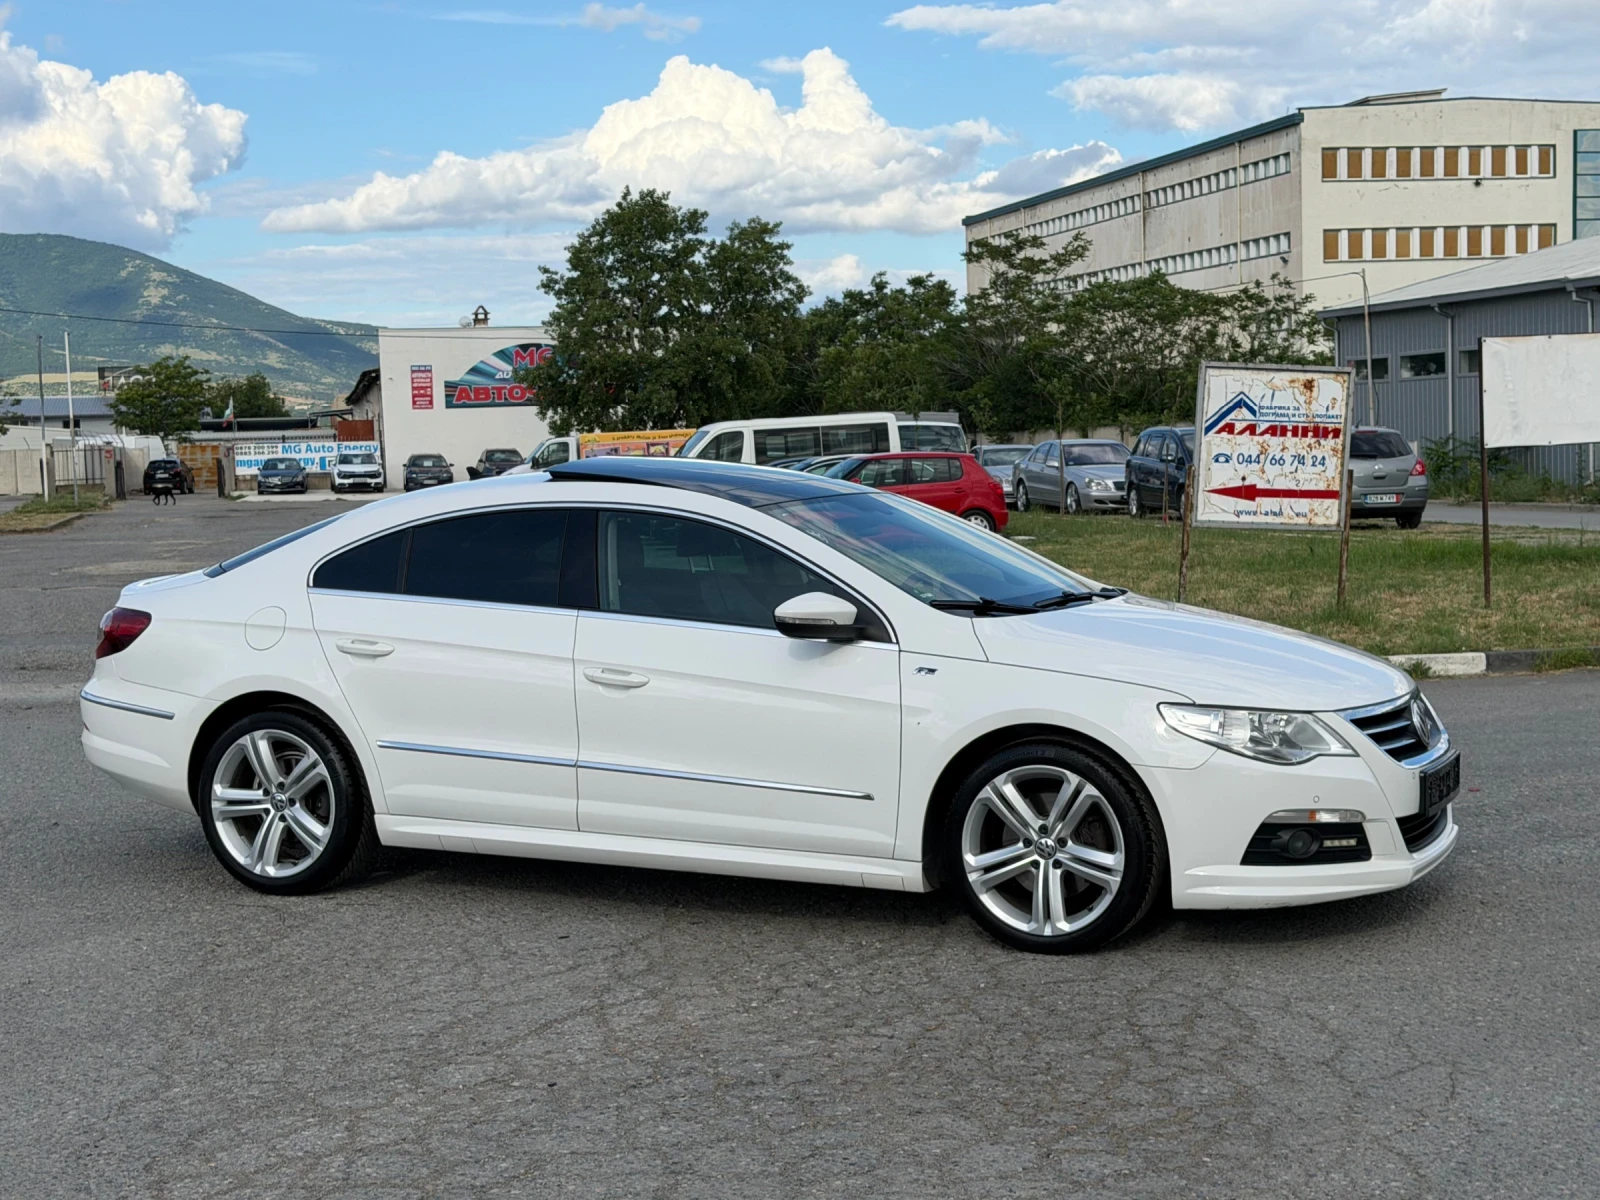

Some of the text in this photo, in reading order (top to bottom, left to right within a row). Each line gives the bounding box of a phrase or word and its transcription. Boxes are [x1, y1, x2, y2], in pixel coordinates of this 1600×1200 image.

[1214, 422, 1341, 439] АЛАННИ
[281, 444, 302, 454] MG
[305, 443, 334, 453] Auto
[337, 443, 379, 454] Energy
[1290, 454, 1306, 467] 74
